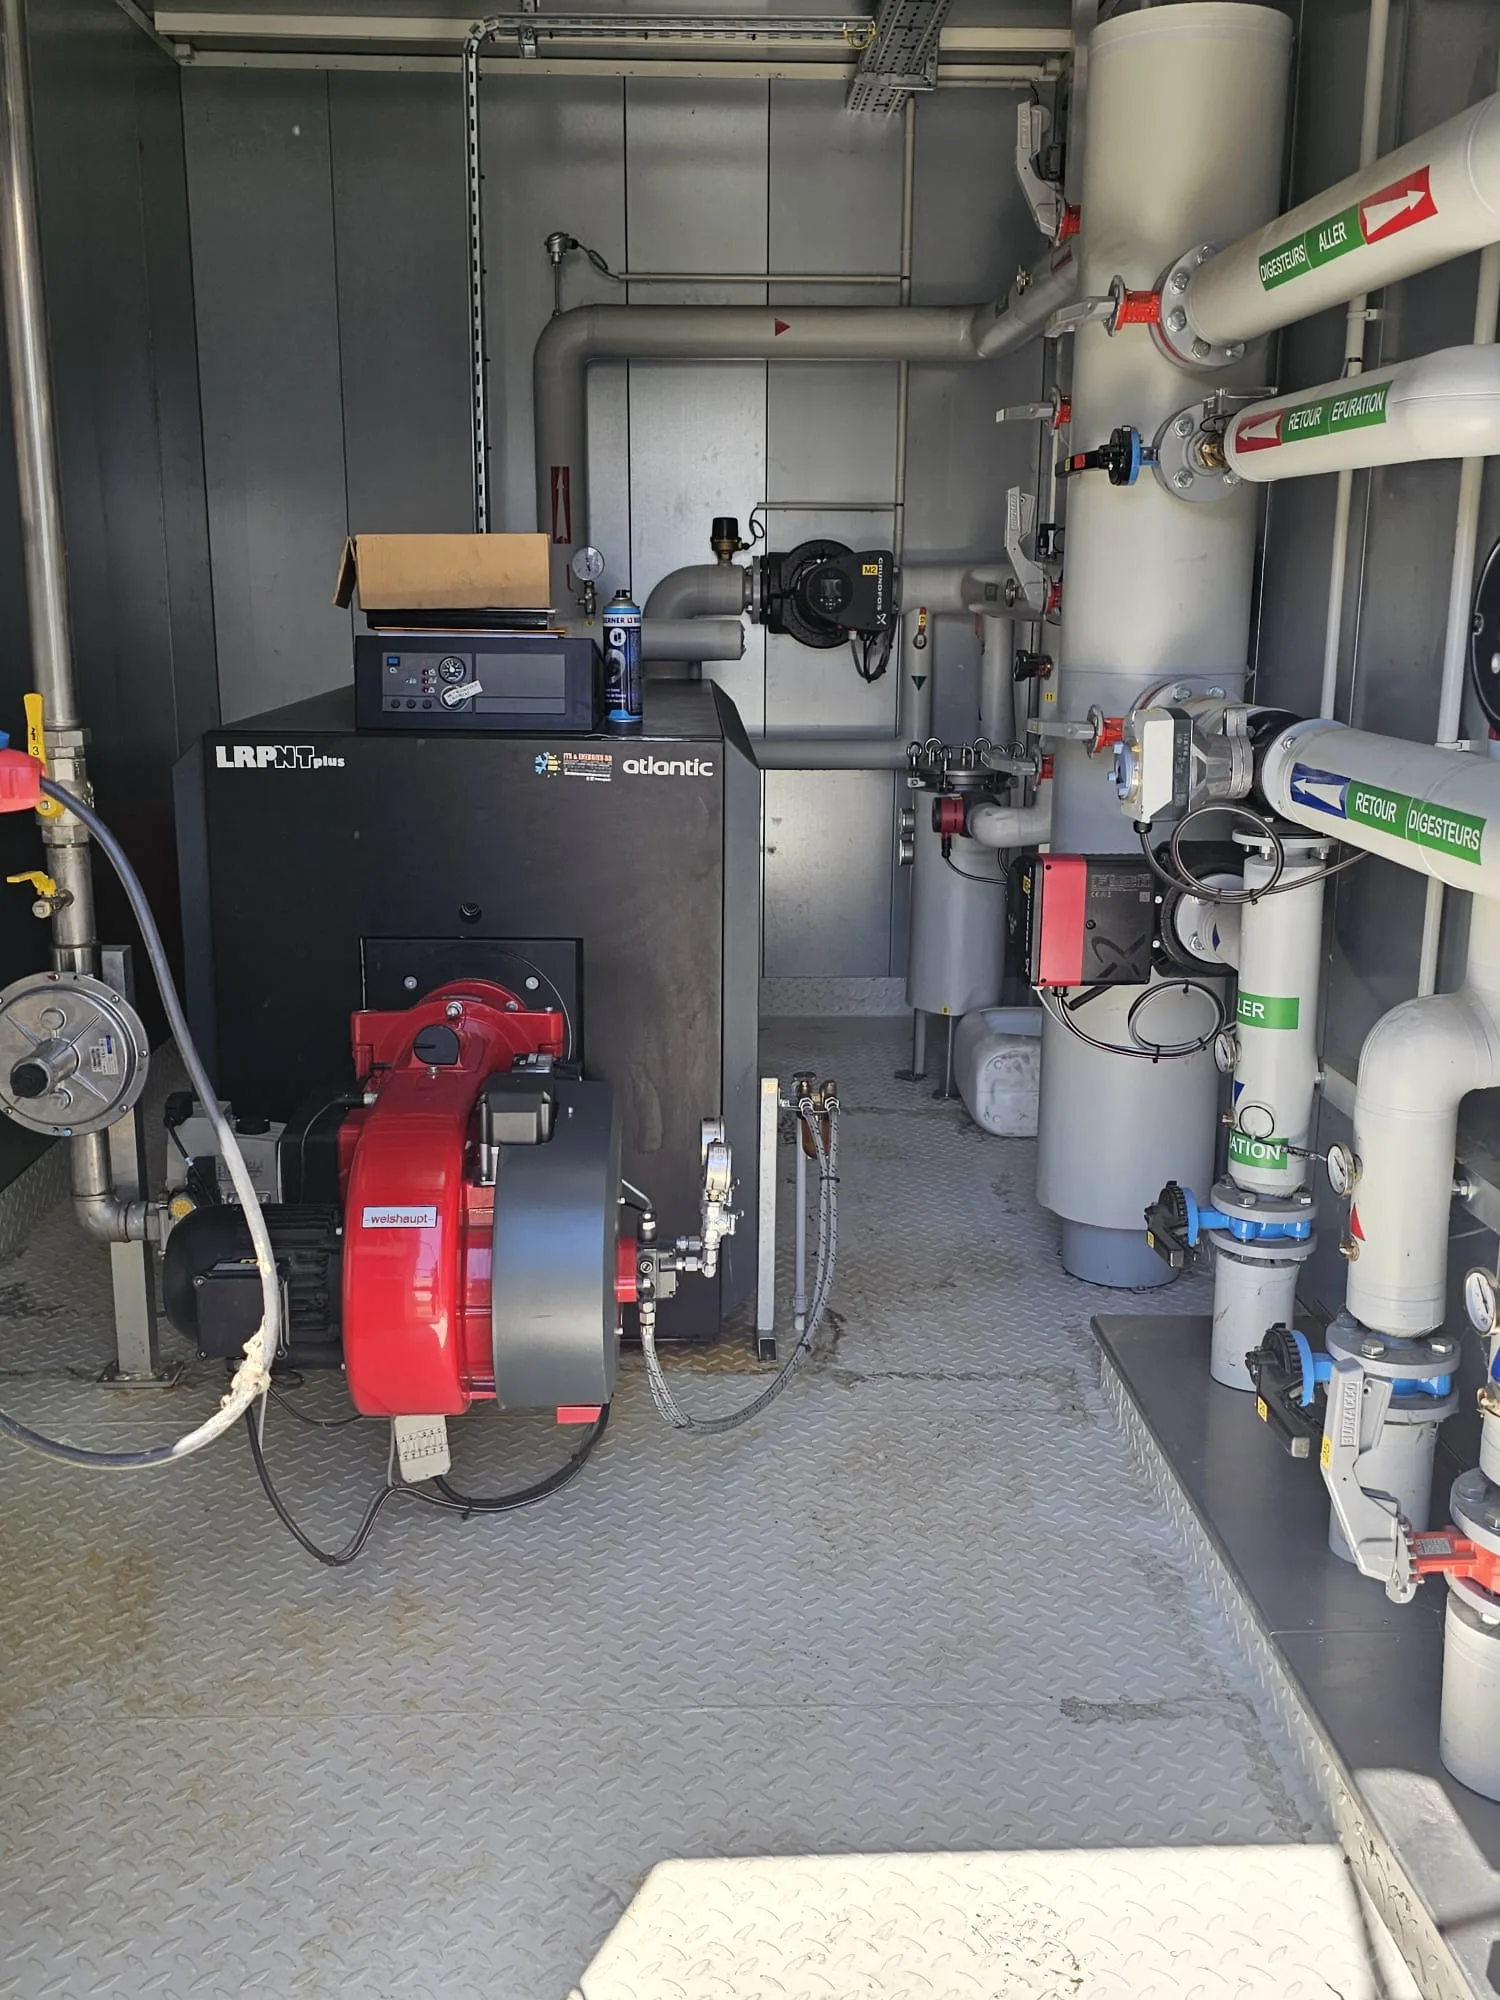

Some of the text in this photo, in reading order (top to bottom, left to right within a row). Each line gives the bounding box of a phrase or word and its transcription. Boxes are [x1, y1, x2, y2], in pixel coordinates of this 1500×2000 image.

[1260, 221, 1347, 282] DIGESTEURS ALLER
[1288, 391, 1385, 431] RETOUR EPURATION
[864, 566, 877, 574] M2
[32, 746, 40, 756] 3
[622, 756, 714, 777] atlantic
[1355, 791, 1480, 851] RETOUR DIGESTEURS
